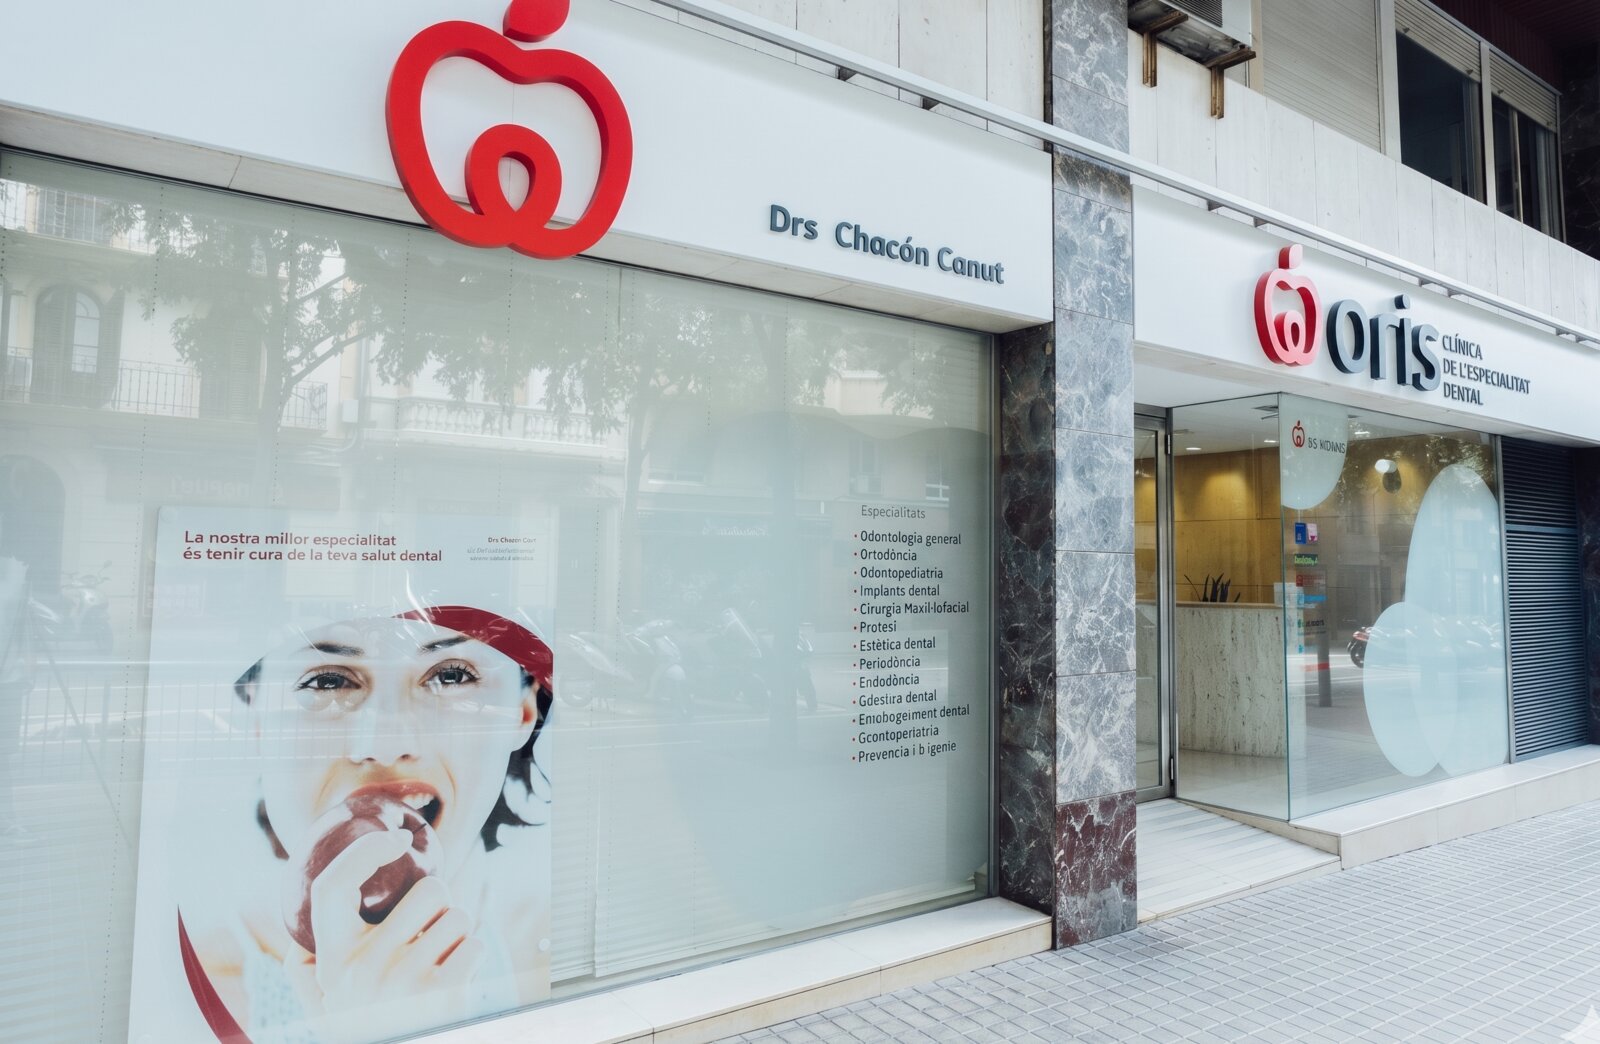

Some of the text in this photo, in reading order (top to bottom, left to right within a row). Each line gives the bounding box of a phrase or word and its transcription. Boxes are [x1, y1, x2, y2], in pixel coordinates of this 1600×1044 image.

[770, 204, 1004, 284] Drs Chacón Canut
[1326, 294, 1441, 391] oris
[1442, 333, 1483, 360] CLÍNICA
[1443, 358, 1458, 375] DE
[1443, 382, 1484, 405] DENTAL
[861, 505, 926, 519] Especialitats
[185, 530, 396, 548] La nostra millor especialitat
[860, 530, 961, 547] Odontologia general
[183, 547, 442, 562] és tenir cura de la teva salut dental
[860, 566, 943, 581] Odontopediatria
[860, 584, 940, 599] Implants dental
[860, 603, 901, 617] Cirurgia
[860, 620, 897, 633] Protesi
[860, 636, 936, 651] Estètica dental
[860, 656, 921, 670] Periodòncia
[859, 673, 920, 688] Endodòncia
[905, 689, 937, 703] dental
[939, 704, 970, 718] dental
[858, 746, 909, 762] Prevencia
